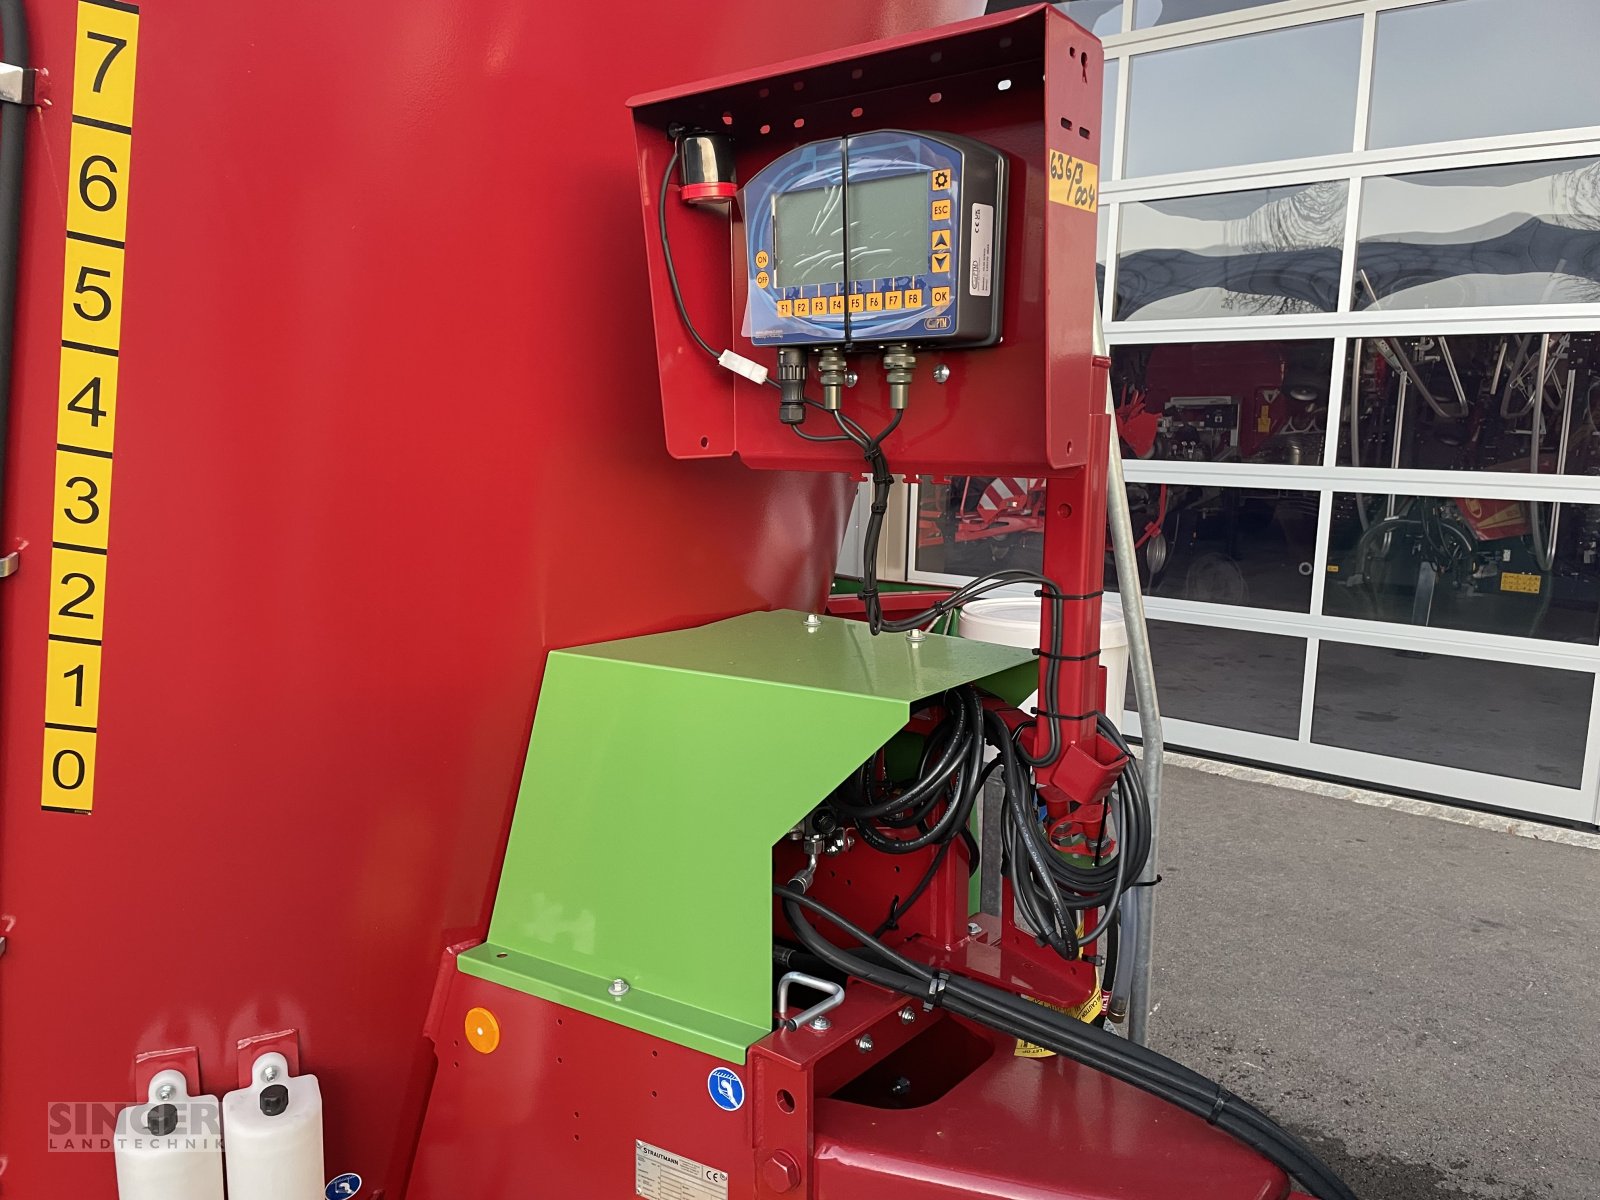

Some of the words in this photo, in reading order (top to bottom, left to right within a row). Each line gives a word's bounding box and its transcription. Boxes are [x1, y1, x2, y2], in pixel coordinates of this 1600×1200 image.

[87, 31, 127, 93] 7
[79, 154, 118, 212] 6
[934, 205, 949, 215] ESC
[758, 255, 768, 264] ON
[757, 276, 768, 284] OFF
[73, 266, 112, 321] 5
[934, 292, 947, 302] OK
[852, 298, 860, 307] F5
[870, 297, 879, 306] F6
[889, 296, 898, 305] F7
[908, 294, 918, 304] F8
[780, 304, 788, 313] F1
[797, 303, 806, 312] F2
[814, 302, 824, 310] F3
[832, 300, 842, 309] F4
[67, 377, 107, 427] 4
[64, 476, 100, 524] 3
[58, 573, 96, 619] 2
[63, 664, 85, 707] 1
[52, 750, 85, 790] 0
[643, 1148, 679, 1166] STRAUTMANN
